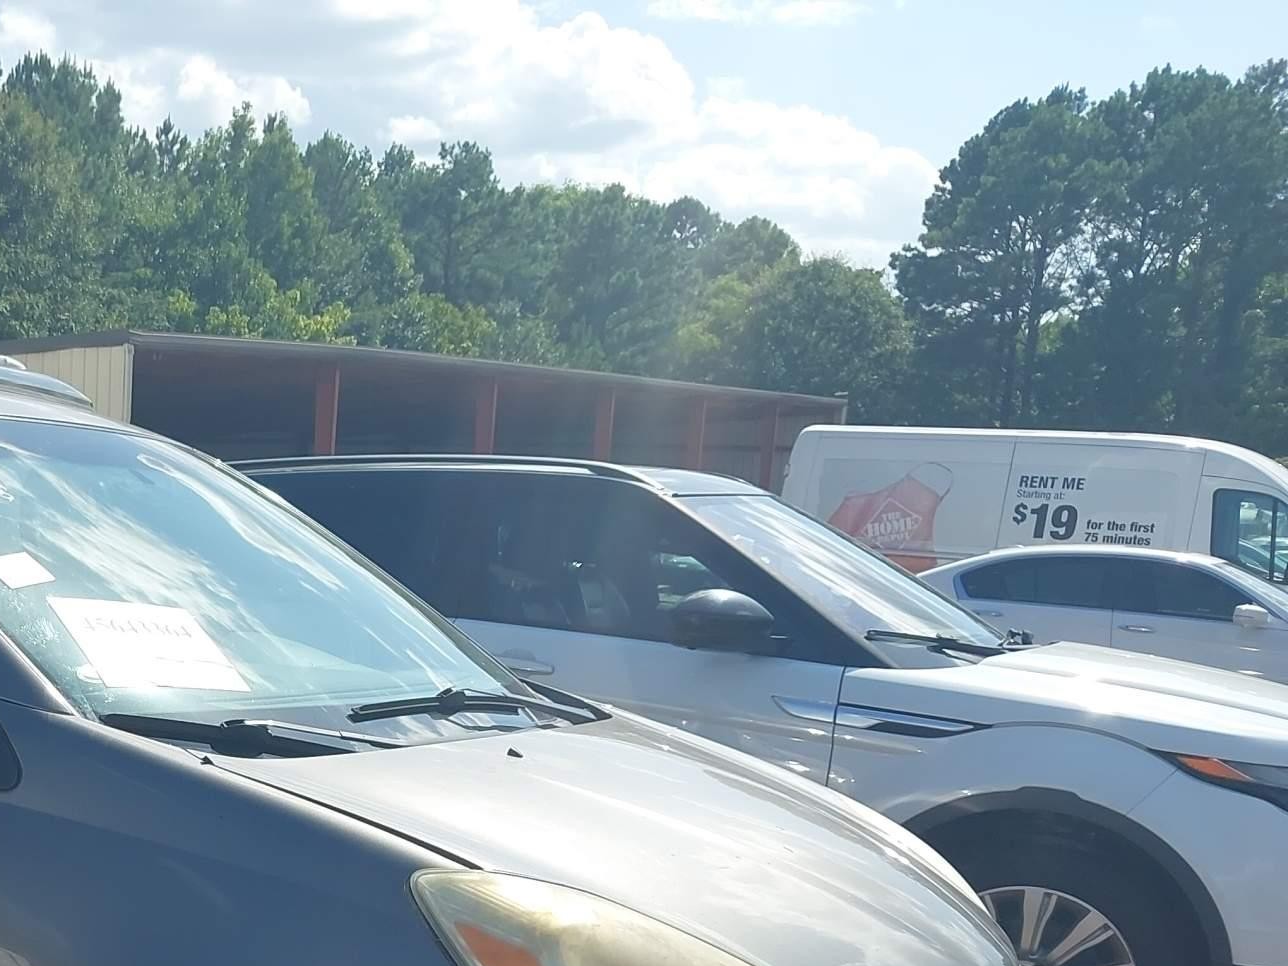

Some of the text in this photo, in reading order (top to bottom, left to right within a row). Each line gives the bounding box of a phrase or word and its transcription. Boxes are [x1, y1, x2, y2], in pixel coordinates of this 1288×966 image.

[1019, 475, 1086, 491] RENT ME
[1016, 489, 1065, 501] Starting at:
[865, 517, 917, 537] HOME
[1012, 502, 1078, 541] $19
[1086, 519, 1155, 533] for the first
[1084, 532, 1151, 546] 75 minutes
